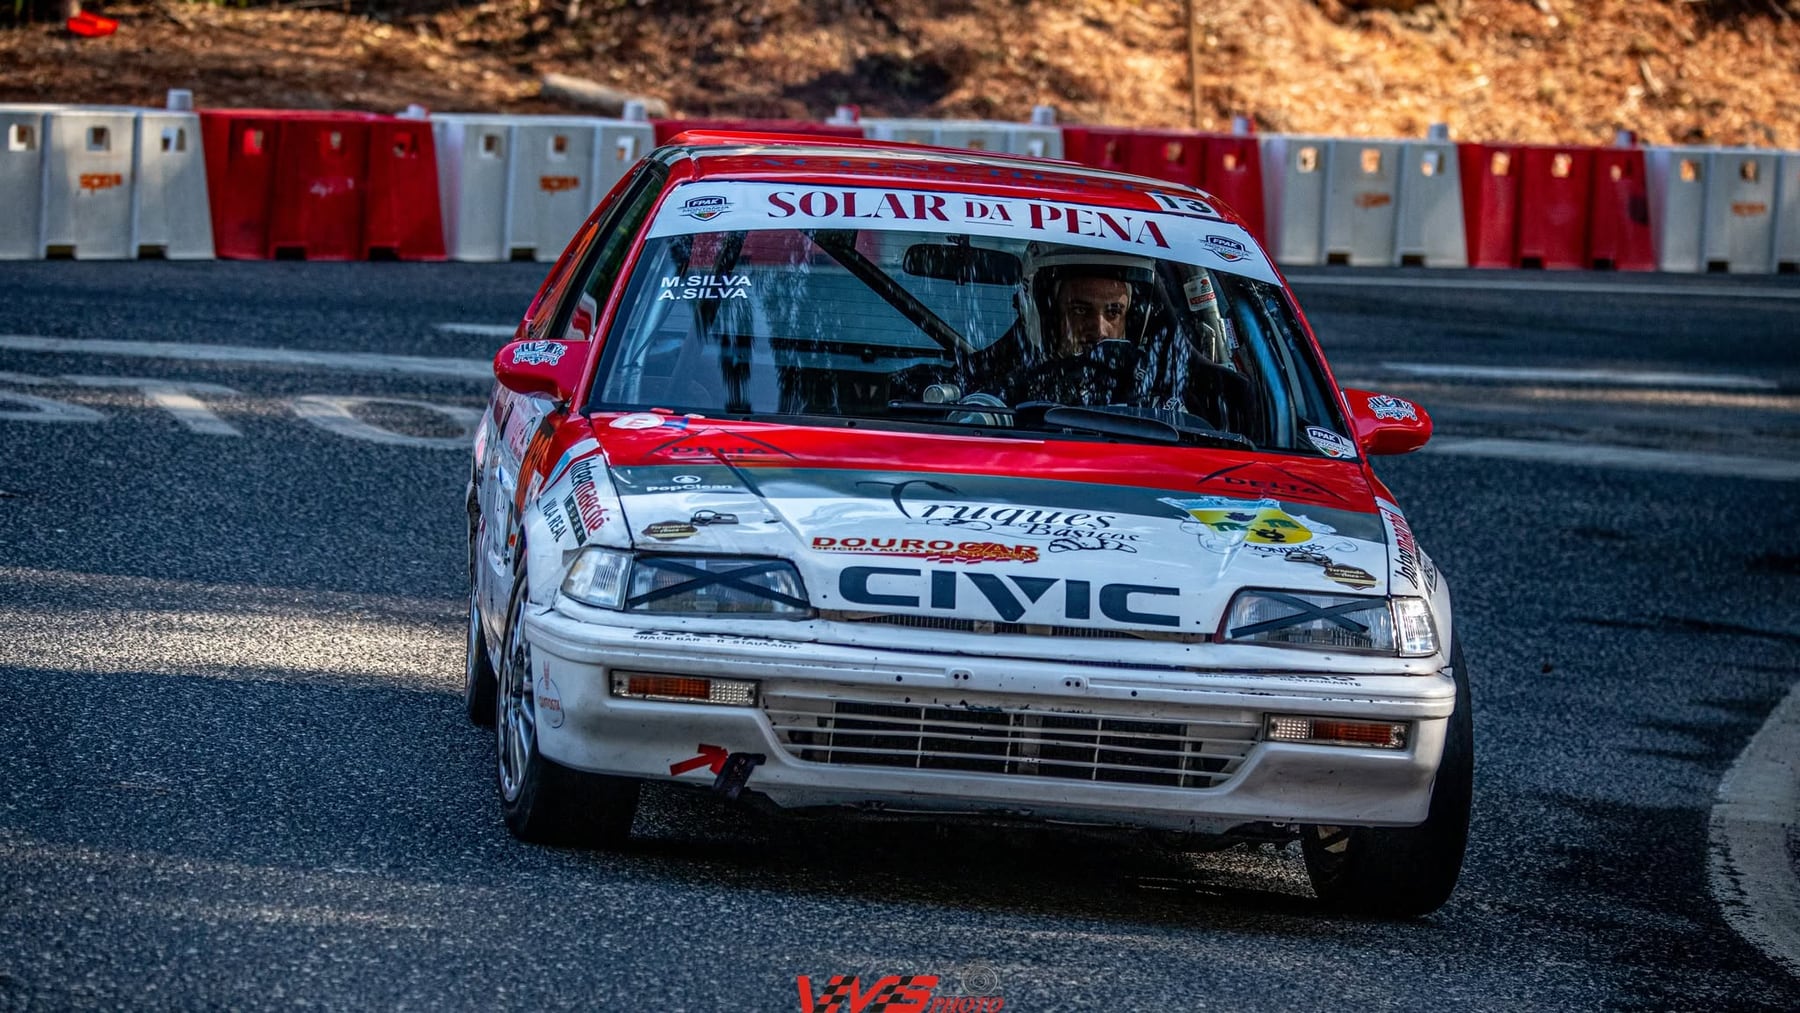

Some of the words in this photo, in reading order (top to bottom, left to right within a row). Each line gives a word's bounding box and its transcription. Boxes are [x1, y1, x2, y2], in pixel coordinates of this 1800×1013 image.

[767, 191, 950, 222] SOLAR
[965, 201, 1012, 221] DA
[1029, 203, 1171, 249] PENA
[1212, 238, 1238, 249] FPAK
[661, 275, 752, 288] M.SILVA
[659, 288, 748, 301] A.SILVA
[1312, 430, 1337, 442] FPAK
[646, 483, 733, 492] PopClean
[1224, 477, 1320, 495] DELTA
[542, 497, 560, 521] VILA
[548, 515, 567, 543] REAL
[566, 503, 585, 539] SUPER
[812, 537, 1039, 556] DOUROCAR
[838, 565, 1181, 628] CIVIC
